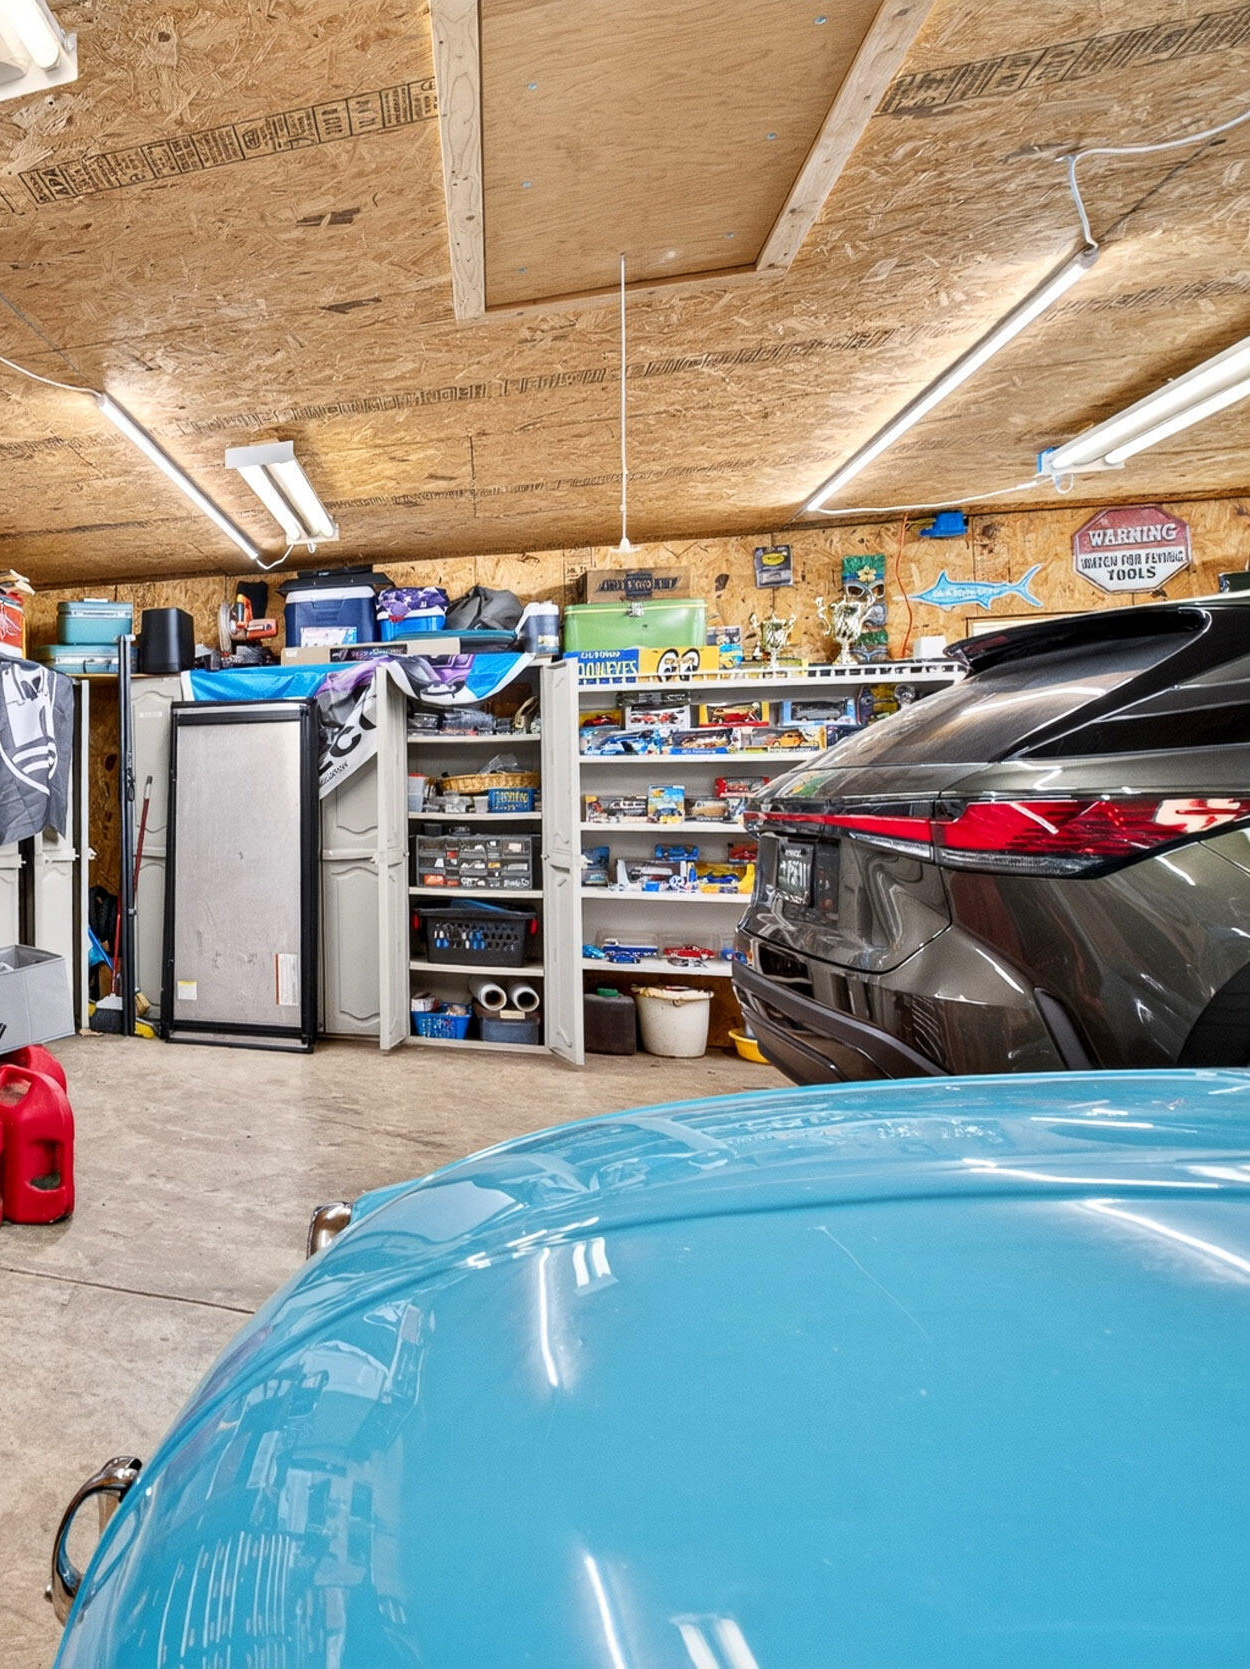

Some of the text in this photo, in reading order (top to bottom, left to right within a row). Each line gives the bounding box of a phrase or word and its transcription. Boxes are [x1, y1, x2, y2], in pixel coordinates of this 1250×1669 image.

[1088, 522, 1178, 547] WARNING
[1080, 550, 1184, 570] WATCH FOR FLYING
[1106, 565, 1157, 581] TOOLS
